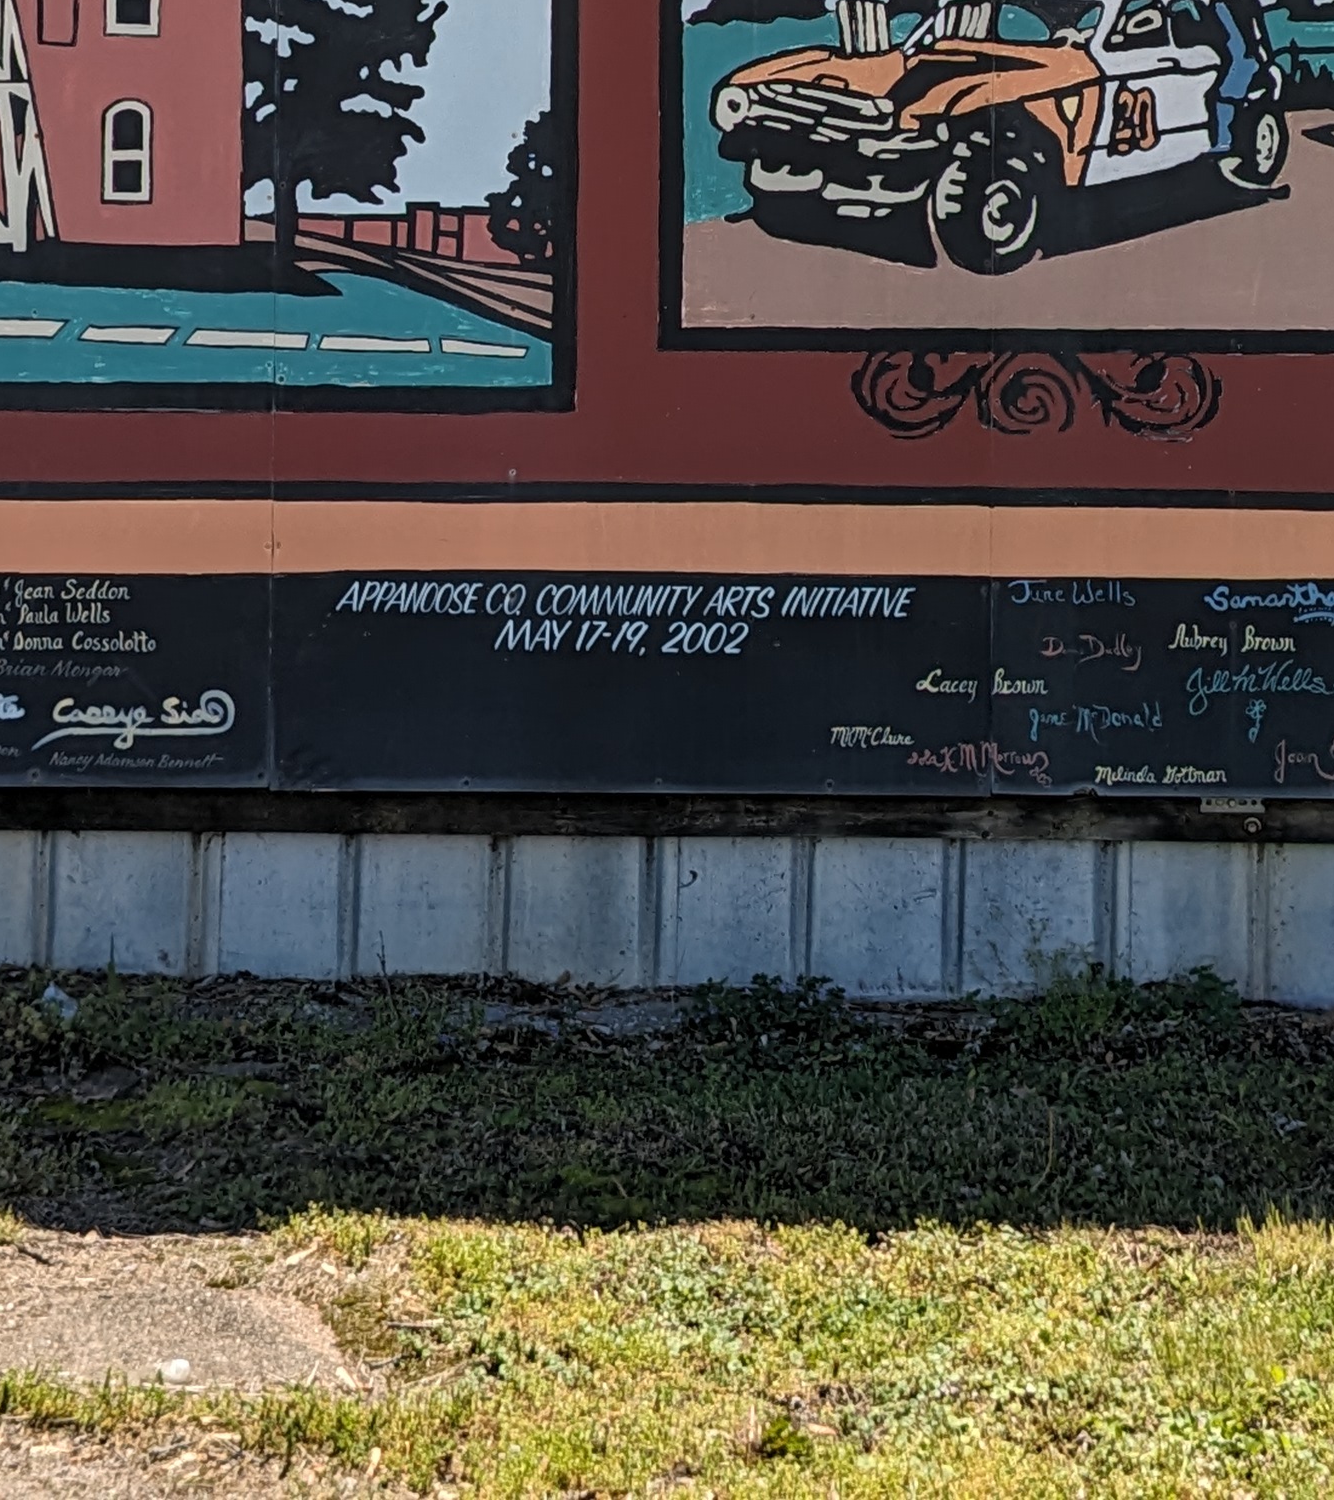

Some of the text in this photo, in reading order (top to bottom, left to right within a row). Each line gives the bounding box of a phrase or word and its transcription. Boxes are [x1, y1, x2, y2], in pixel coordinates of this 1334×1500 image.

[14, 578, 54, 607] Jean
[61, 578, 130, 601] Seddon
[335, 581, 483, 614] APPANOOSE
[534, 584, 699, 617] COMMUNITY
[703, 585, 773, 618] ARTS
[781, 586, 916, 618] INITIATIVE
[1008, 580, 1136, 606] June Wells
[17, 603, 59, 625] Paula
[65, 602, 111, 624] Wells
[12, 630, 63, 651] Donna
[71, 630, 157, 652] Cossolotto
[494, 620, 749, 656] MAY 17-19, 2002
[1168, 623, 1296, 656] Aubrey Brown
[916, 668, 1049, 703] Lacey Brown
[1186, 665, 1230, 715] Jill
[1257, 659, 1327, 694] Wells
